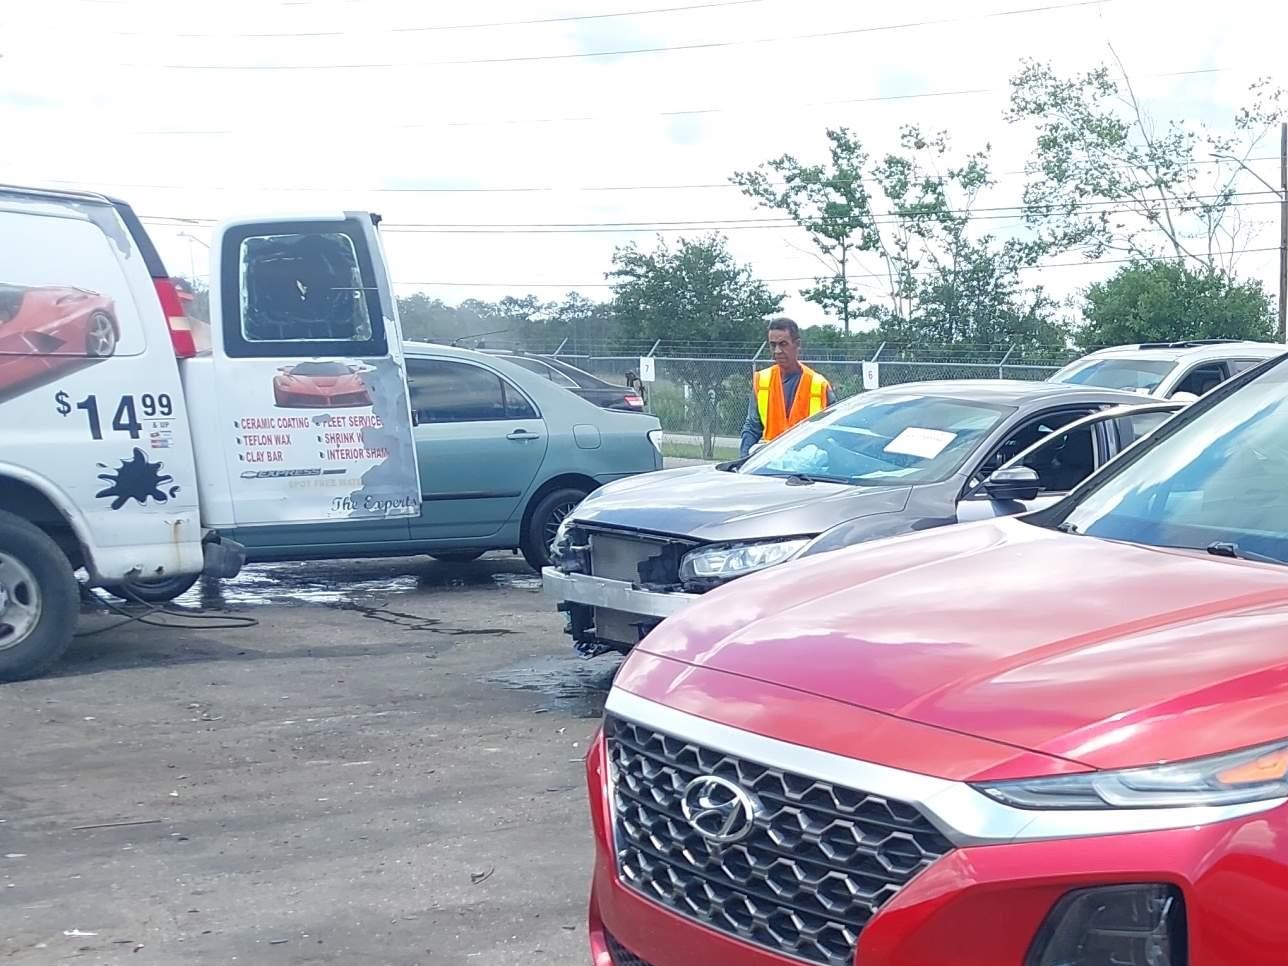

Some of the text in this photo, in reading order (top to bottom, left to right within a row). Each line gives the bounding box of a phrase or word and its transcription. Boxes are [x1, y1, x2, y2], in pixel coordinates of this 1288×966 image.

[241, 417, 310, 429] CERAMIC COATING
[244, 434, 292, 446] TEFLON WAX
[325, 432, 355, 444] SHRINK
[246, 451, 283, 462] CLAY BAR
[327, 449, 364, 460] INTERIOR
[331, 495, 417, 514] The Experts
